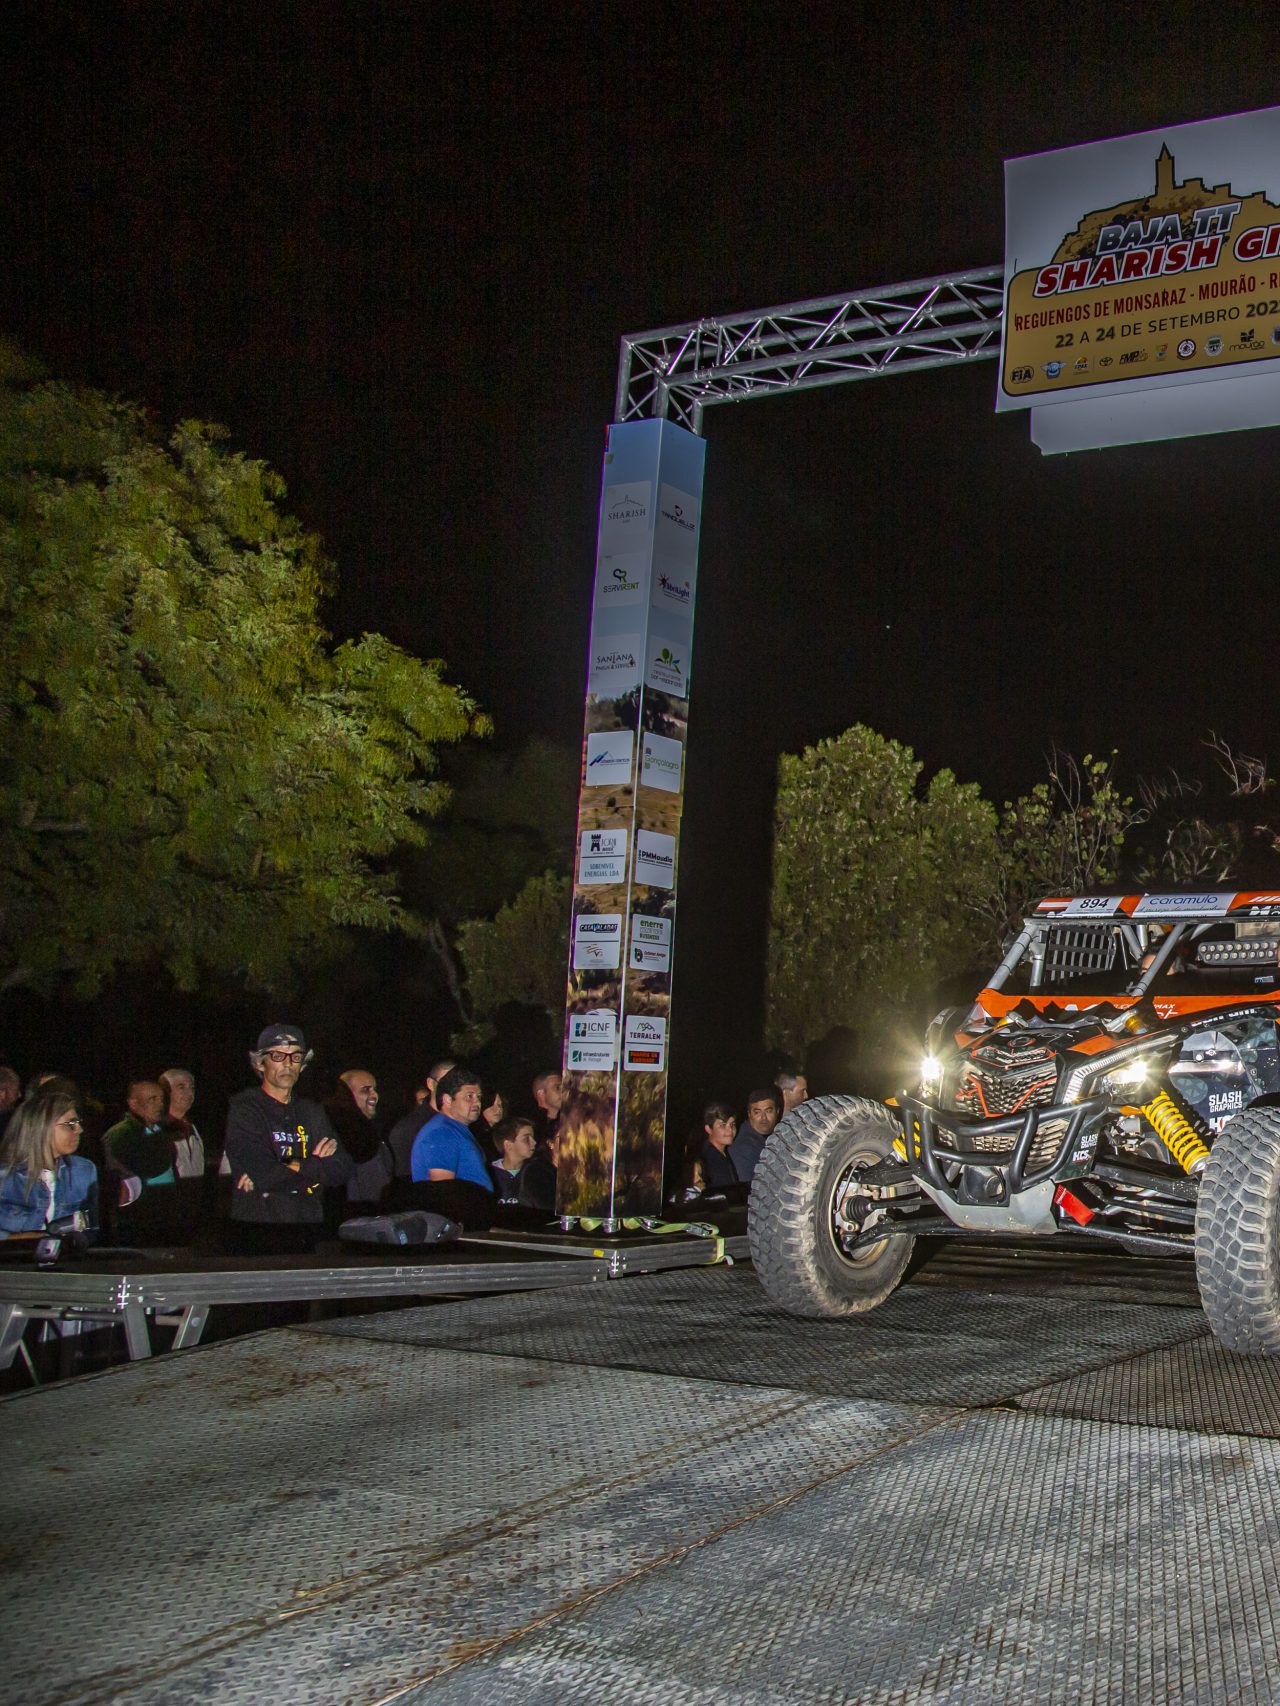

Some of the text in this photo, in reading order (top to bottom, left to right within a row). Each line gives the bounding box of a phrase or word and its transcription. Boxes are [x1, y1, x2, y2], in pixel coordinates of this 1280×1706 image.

[1096, 201, 1243, 256] BAJA TT
[1033, 234, 1224, 298] SHARISH
[1015, 304, 1090, 331] REGUENGOS
[1094, 300, 1109, 318] DE
[1114, 288, 1186, 315] MONSARAZ
[1199, 274, 1256, 301] MOURÃO
[1055, 333, 1074, 348] 22
[1079, 331, 1090, 344] A
[1096, 326, 1116, 342] 24
[1121, 323, 1142, 337] DE
[1148, 307, 1240, 333] SETEMBRO
[1011, 368, 1033, 382] FIA
[608, 509, 646, 520] SHARISH
[603, 582, 639, 592] SERVIRENT
[1079, 897, 1110, 909] 894
[1149, 895, 1218, 905] caramulo
[588, 1022, 610, 1032] ICNF
[630, 1031, 661, 1040] TERRALEM
[1209, 1090, 1242, 1106] SLASH
[1210, 1101, 1243, 1113] GRAPHICS
